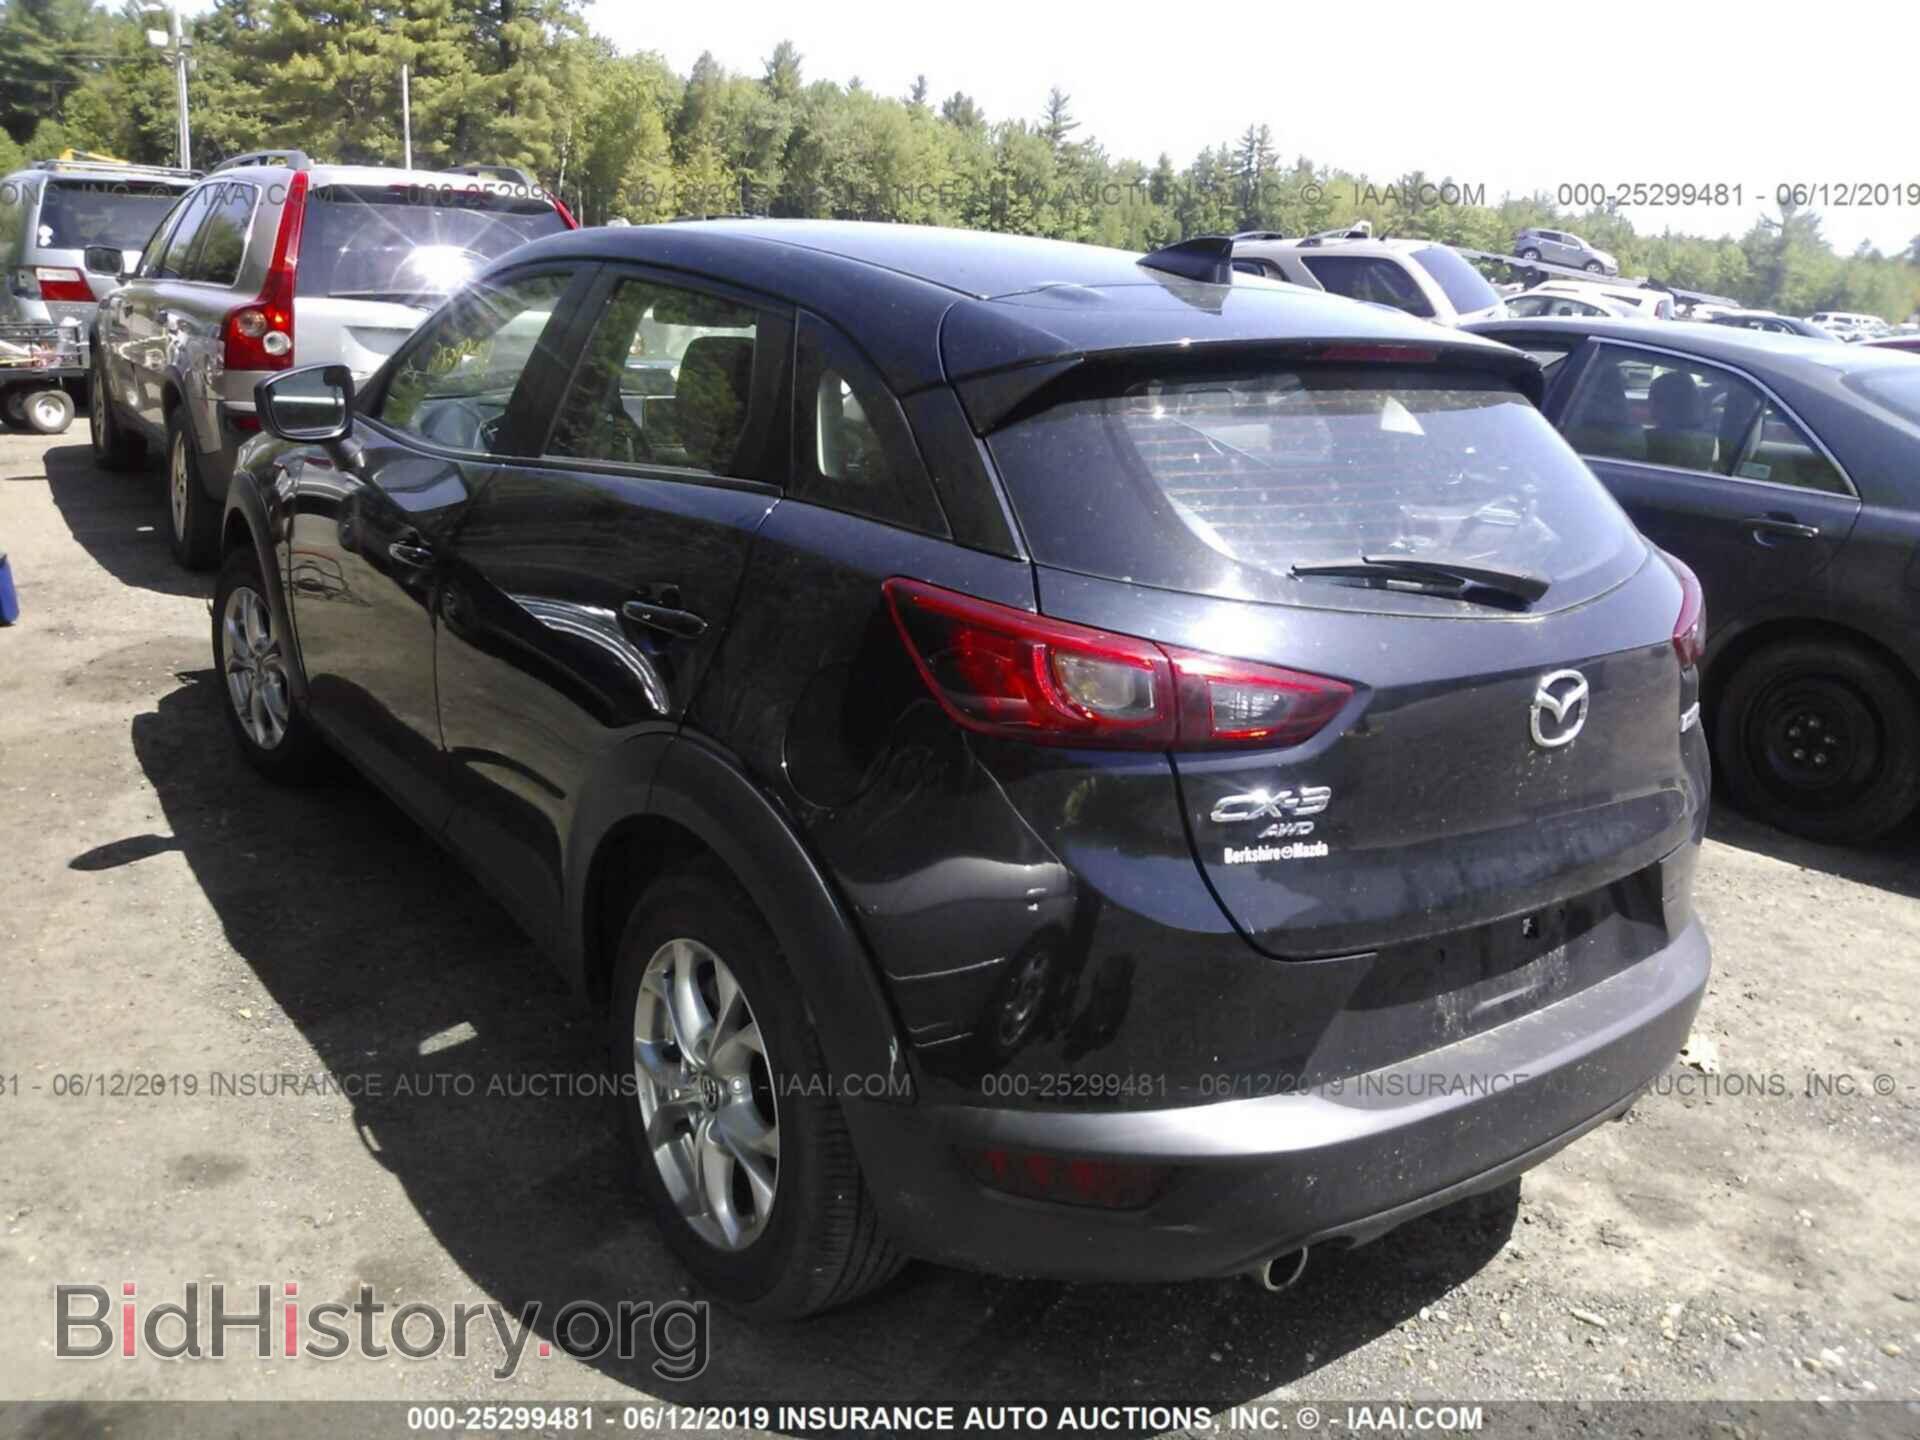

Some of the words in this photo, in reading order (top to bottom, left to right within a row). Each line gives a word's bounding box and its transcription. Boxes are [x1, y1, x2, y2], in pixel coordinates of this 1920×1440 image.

[1210, 786, 1332, 822] CX-3
[1257, 821, 1314, 839] AWD
[1224, 845, 1280, 864] Berkshire
[1292, 840, 1328, 859] Mazda
